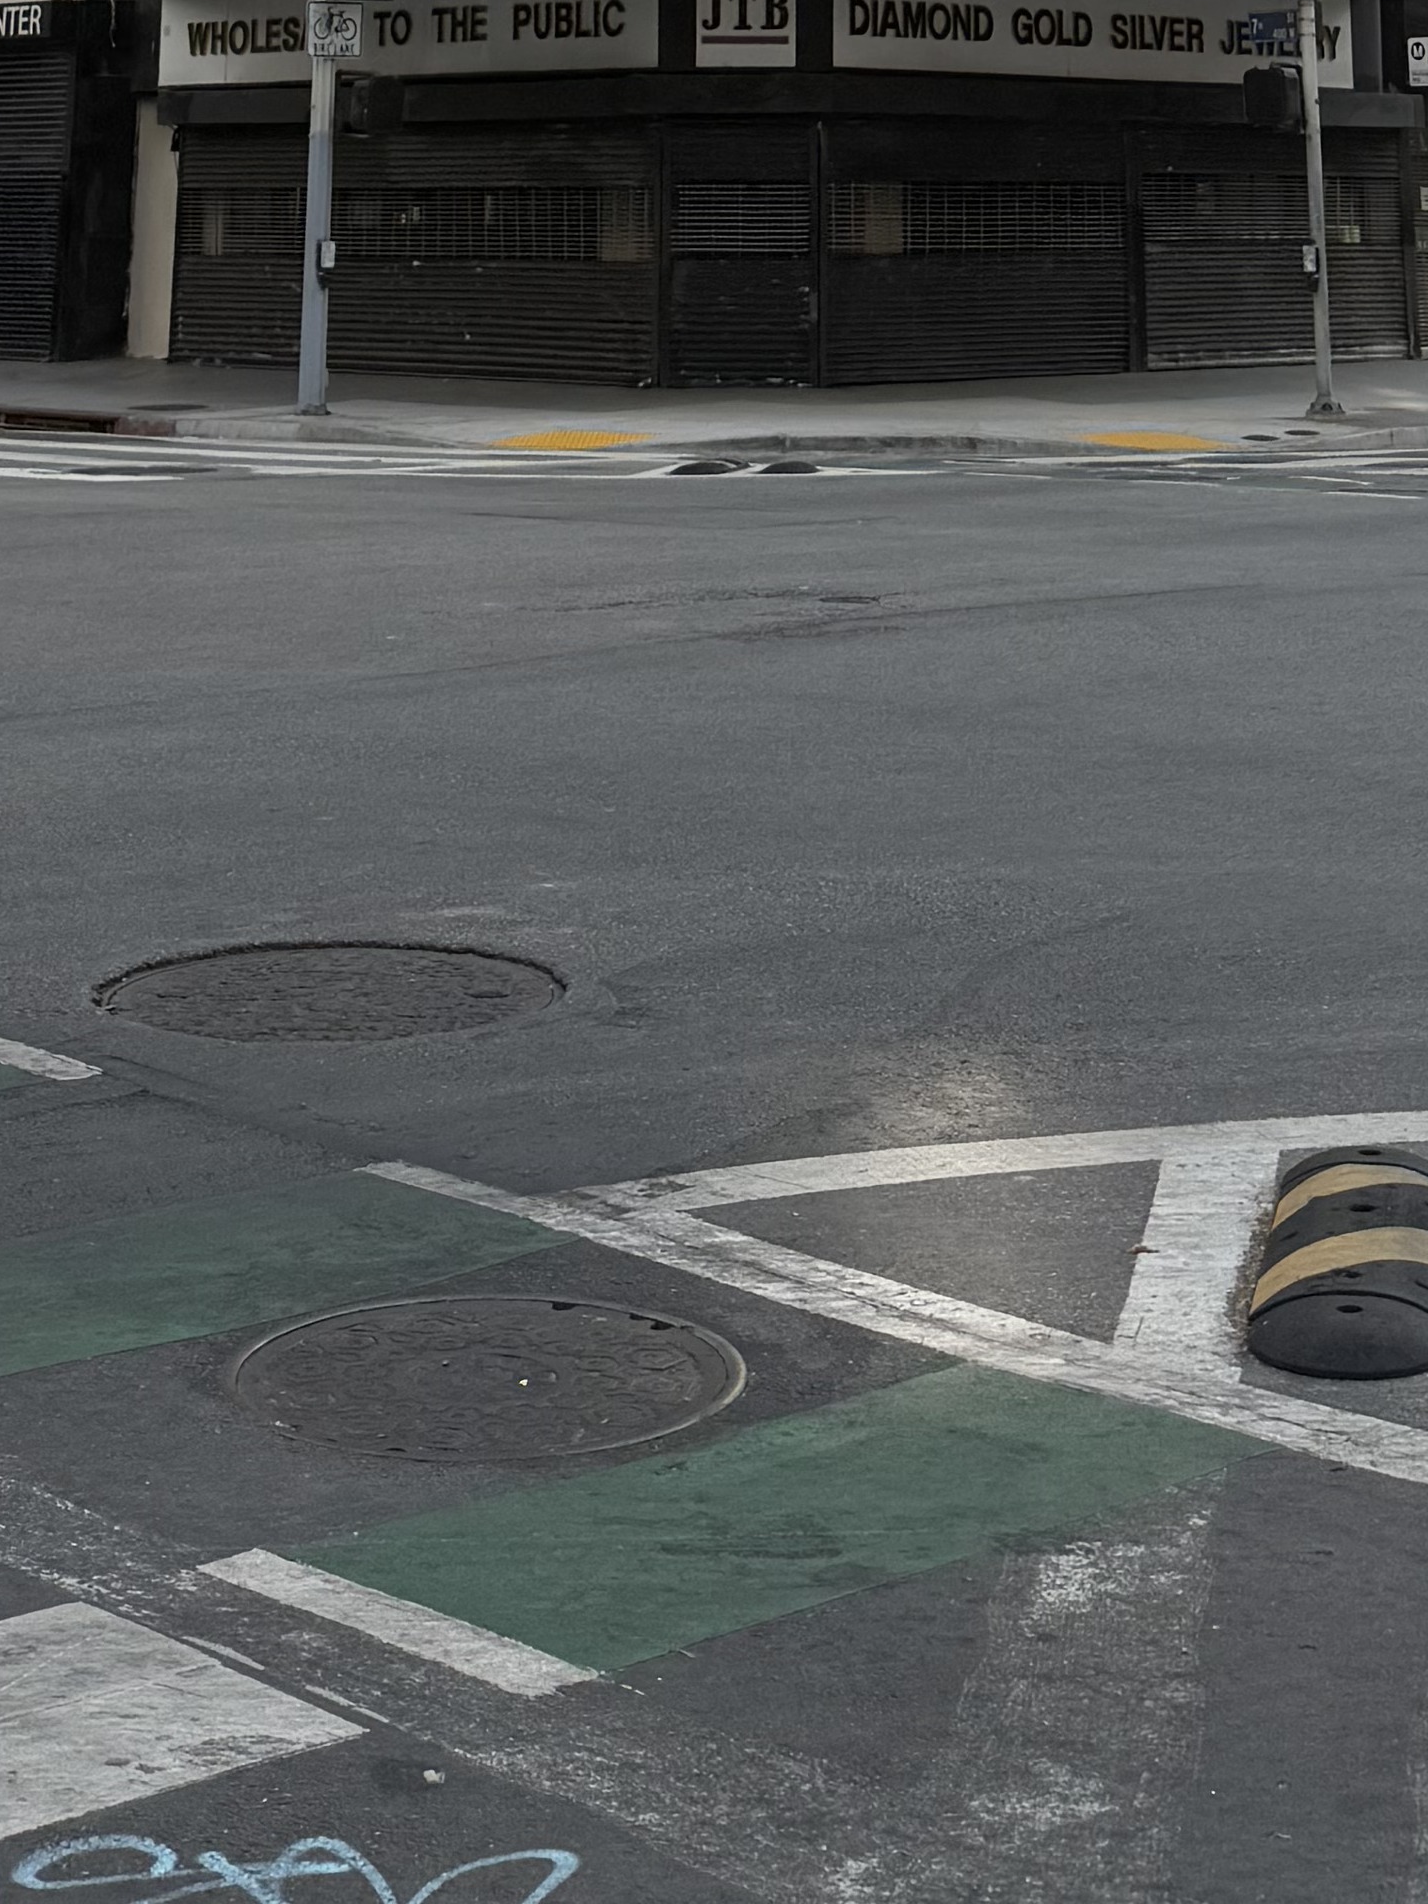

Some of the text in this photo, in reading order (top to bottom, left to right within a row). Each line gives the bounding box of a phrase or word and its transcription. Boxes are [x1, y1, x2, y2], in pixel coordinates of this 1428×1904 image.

[373, 9, 413, 47] TO
[431, 3, 489, 44] THE
[1011, 7, 1093, 48] GOLD
[1109, 12, 1204, 54] SILVER
